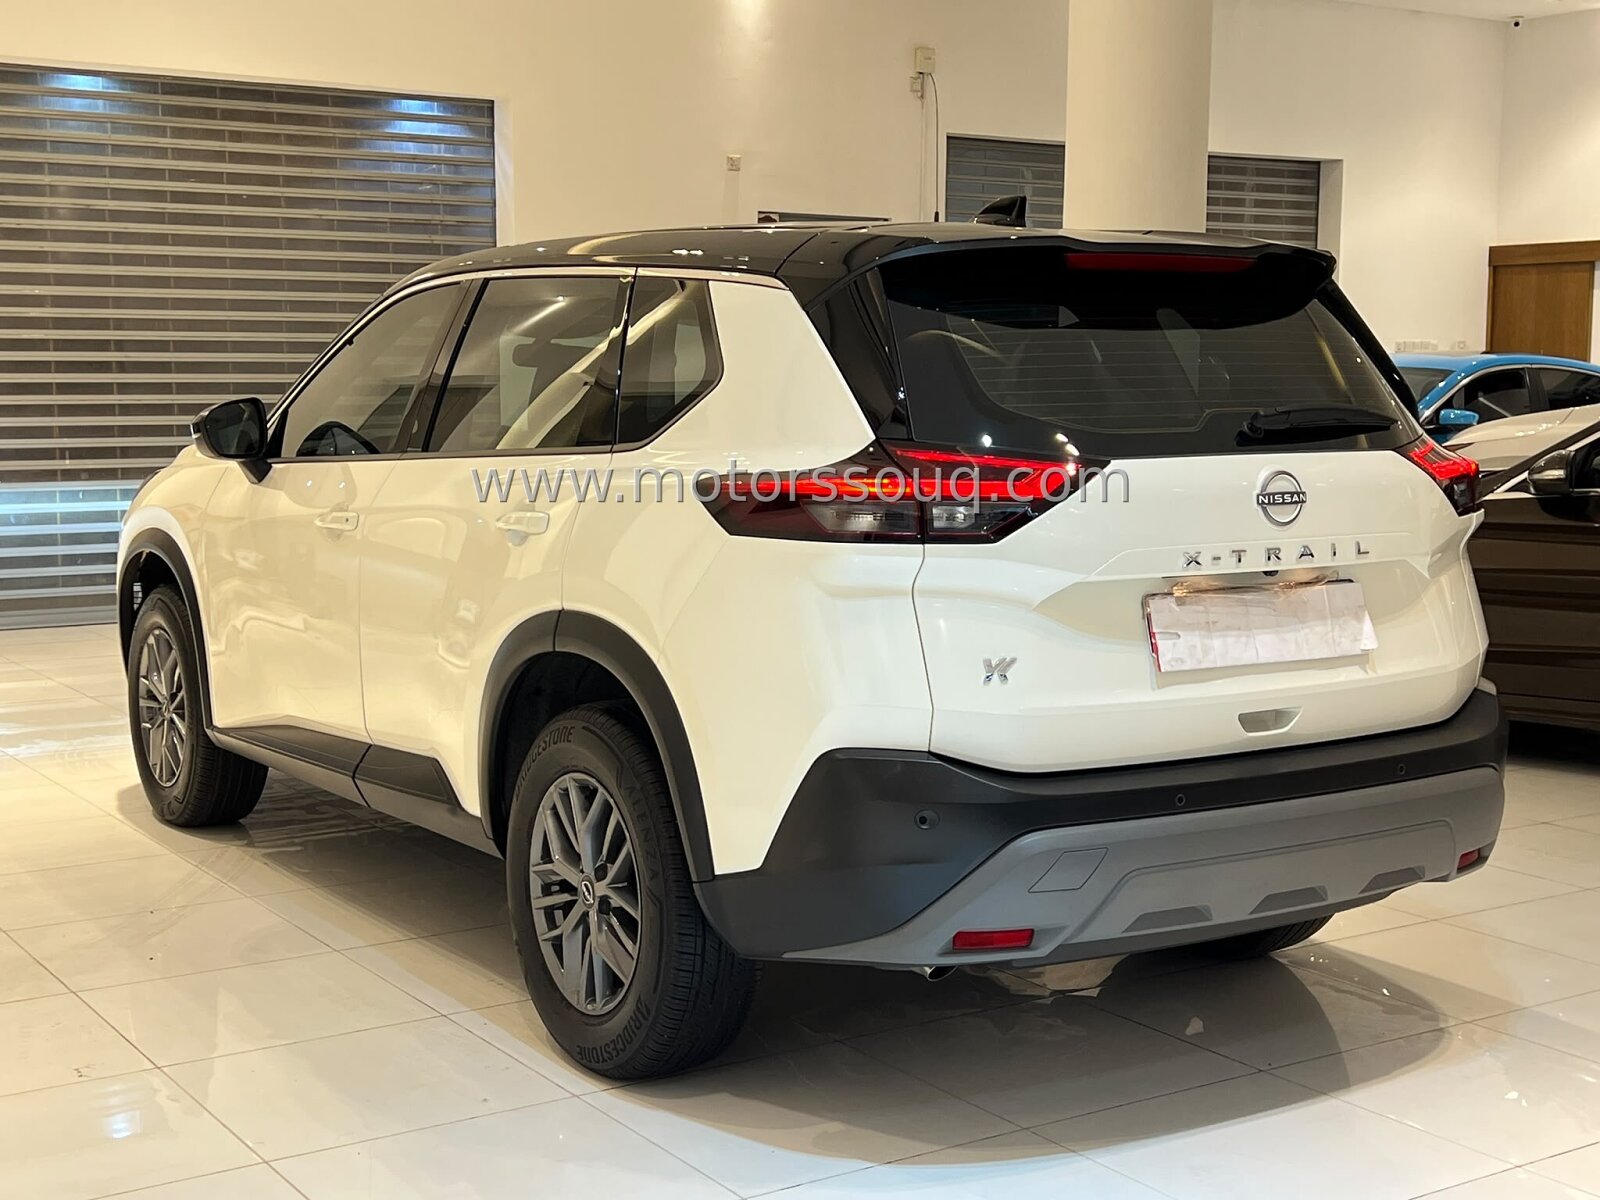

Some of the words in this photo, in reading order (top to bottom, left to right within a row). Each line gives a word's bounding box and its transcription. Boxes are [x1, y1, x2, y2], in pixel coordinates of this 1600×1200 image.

[1258, 493, 1307, 504] NISSAN
[1183, 540, 1370, 568] X-TRAIL
[576, 992, 650, 1065] BRIDGESTONE
